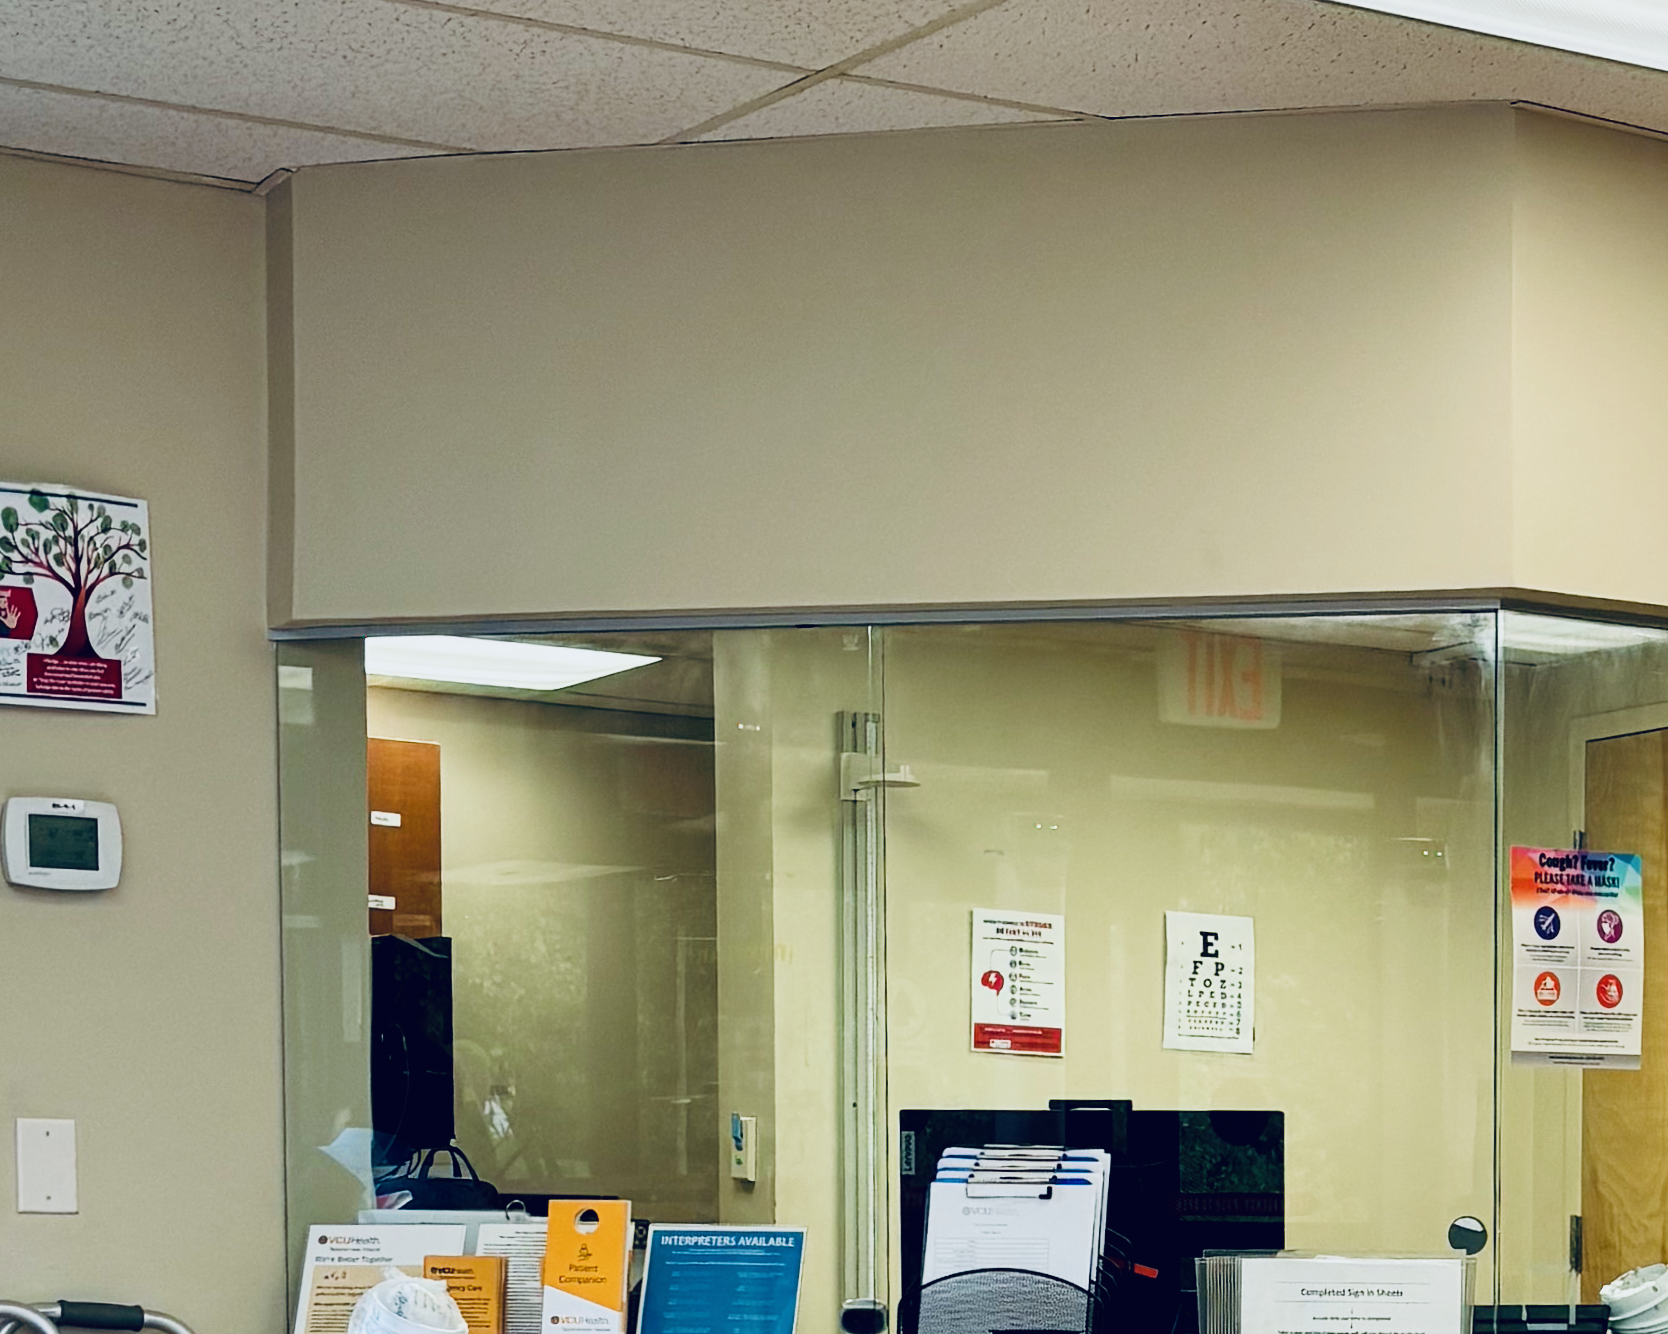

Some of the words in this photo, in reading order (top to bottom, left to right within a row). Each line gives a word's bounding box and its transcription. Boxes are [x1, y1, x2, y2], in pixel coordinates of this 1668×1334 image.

[1538, 853, 1579, 871] Cough?
[1580, 855, 1616, 872] Fever?
[1534, 871, 1564, 885] PLEASE
[1566, 873, 1587, 887] TAKE
[1588, 875, 1593, 887] A
[1594, 876, 1620, 889] MASK!
[1199, 931, 1219, 958] E
[1192, 960, 1203, 975] F
[1214, 961, 1225, 976] P
[1188, 977, 1196, 987] T
[1203, 978, 1212, 988] O
[1220, 979, 1227, 989] Z
[903, 1134, 912, 1172] Lenovo
[660, 1235, 737, 1247] INTERPRETERS
[737, 1236, 796, 1248] AVAILABLE
[568, 1263, 599, 1272] Patient
[558, 1275, 608, 1285] Companion
[1300, 1287, 1346, 1298] Completed
[1347, 1287, 1365, 1298] Sign
[1366, 1287, 1375, 1297] in
[1376, 1288, 1404, 1298] Sheets
